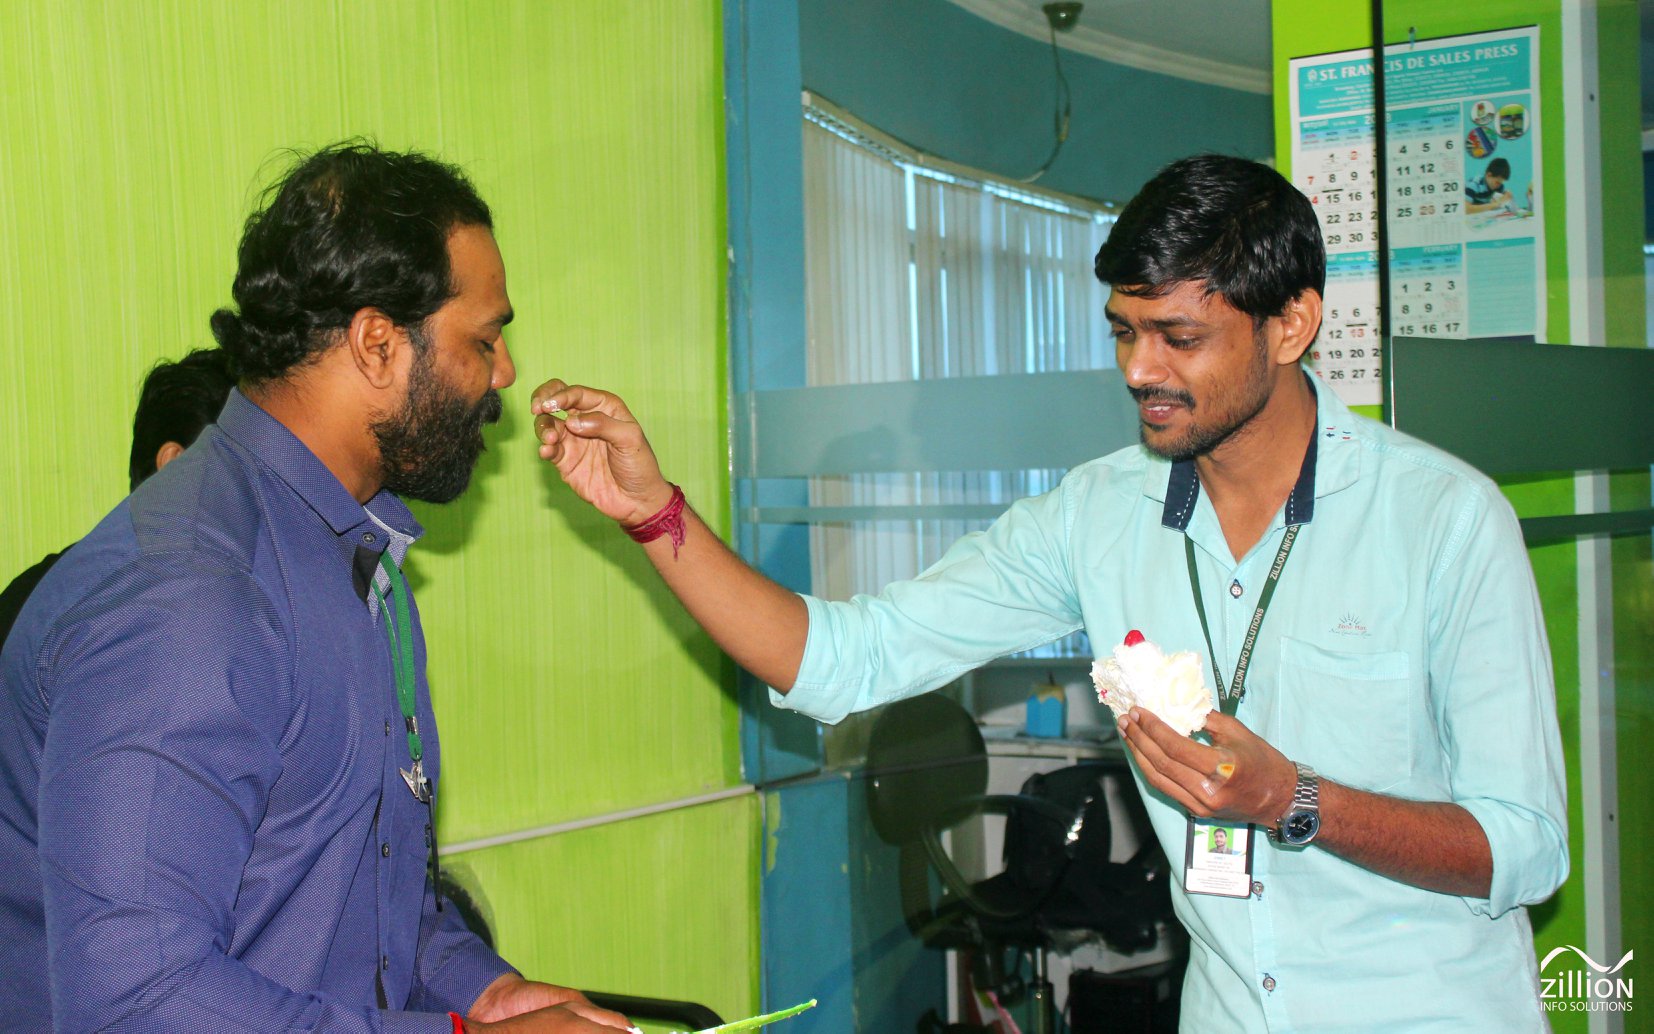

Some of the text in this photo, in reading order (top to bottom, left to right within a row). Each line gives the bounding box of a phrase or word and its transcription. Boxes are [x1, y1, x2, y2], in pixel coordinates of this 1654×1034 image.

[1320, 68, 1338, 81] ST.
[1407, 56, 1425, 69] DE
[1429, 50, 1471, 67] SALES
[1475, 43, 1518, 61] PRESS
[1399, 145, 1408, 154] 4
[1422, 142, 1431, 152] 5
[1445, 140, 1454, 150] 6
[1307, 175, 1315, 185] 7
[1328, 173, 1336, 183] 8
[1350, 171, 1359, 181] 9
[1396, 165, 1411, 175] 11
[1419, 163, 1435, 173] 12
[1326, 194, 1341, 204] 15
[1348, 191, 1363, 202] 16
[1396, 186, 1412, 197] 18
[1420, 184, 1436, 195] 19
[1443, 181, 1459, 193] 20
[1326, 214, 1341, 225] 22
[1348, 212, 1363, 222] 23
[1397, 207, 1413, 218] 25
[1443, 202, 1460, 214] 27
[1327, 234, 1342, 245] 29
[1349, 232, 1364, 243] 30
[1331, 309, 1339, 319] 5
[1352, 308, 1360, 317] 6
[1402, 283, 1408, 293] 1
[1424, 282, 1432, 292] 2
[1447, 280, 1456, 291] 3
[1328, 329, 1343, 339] 12
[1401, 304, 1410, 315] 8
[1424, 303, 1433, 313] 9
[1328, 350, 1343, 359] 19
[1349, 348, 1365, 358] 20
[1399, 325, 1414, 335] 15
[1421, 324, 1437, 334] 16
[1445, 322, 1460, 333] 17
[1330, 370, 1344, 380] 26
[1352, 369, 1366, 379] 27
[1270, 551, 1288, 581] ZILLION
[1282, 533, 1295, 551] INFO
[1232, 607, 1264, 699] ZILLION INFO SOLUTIONS
